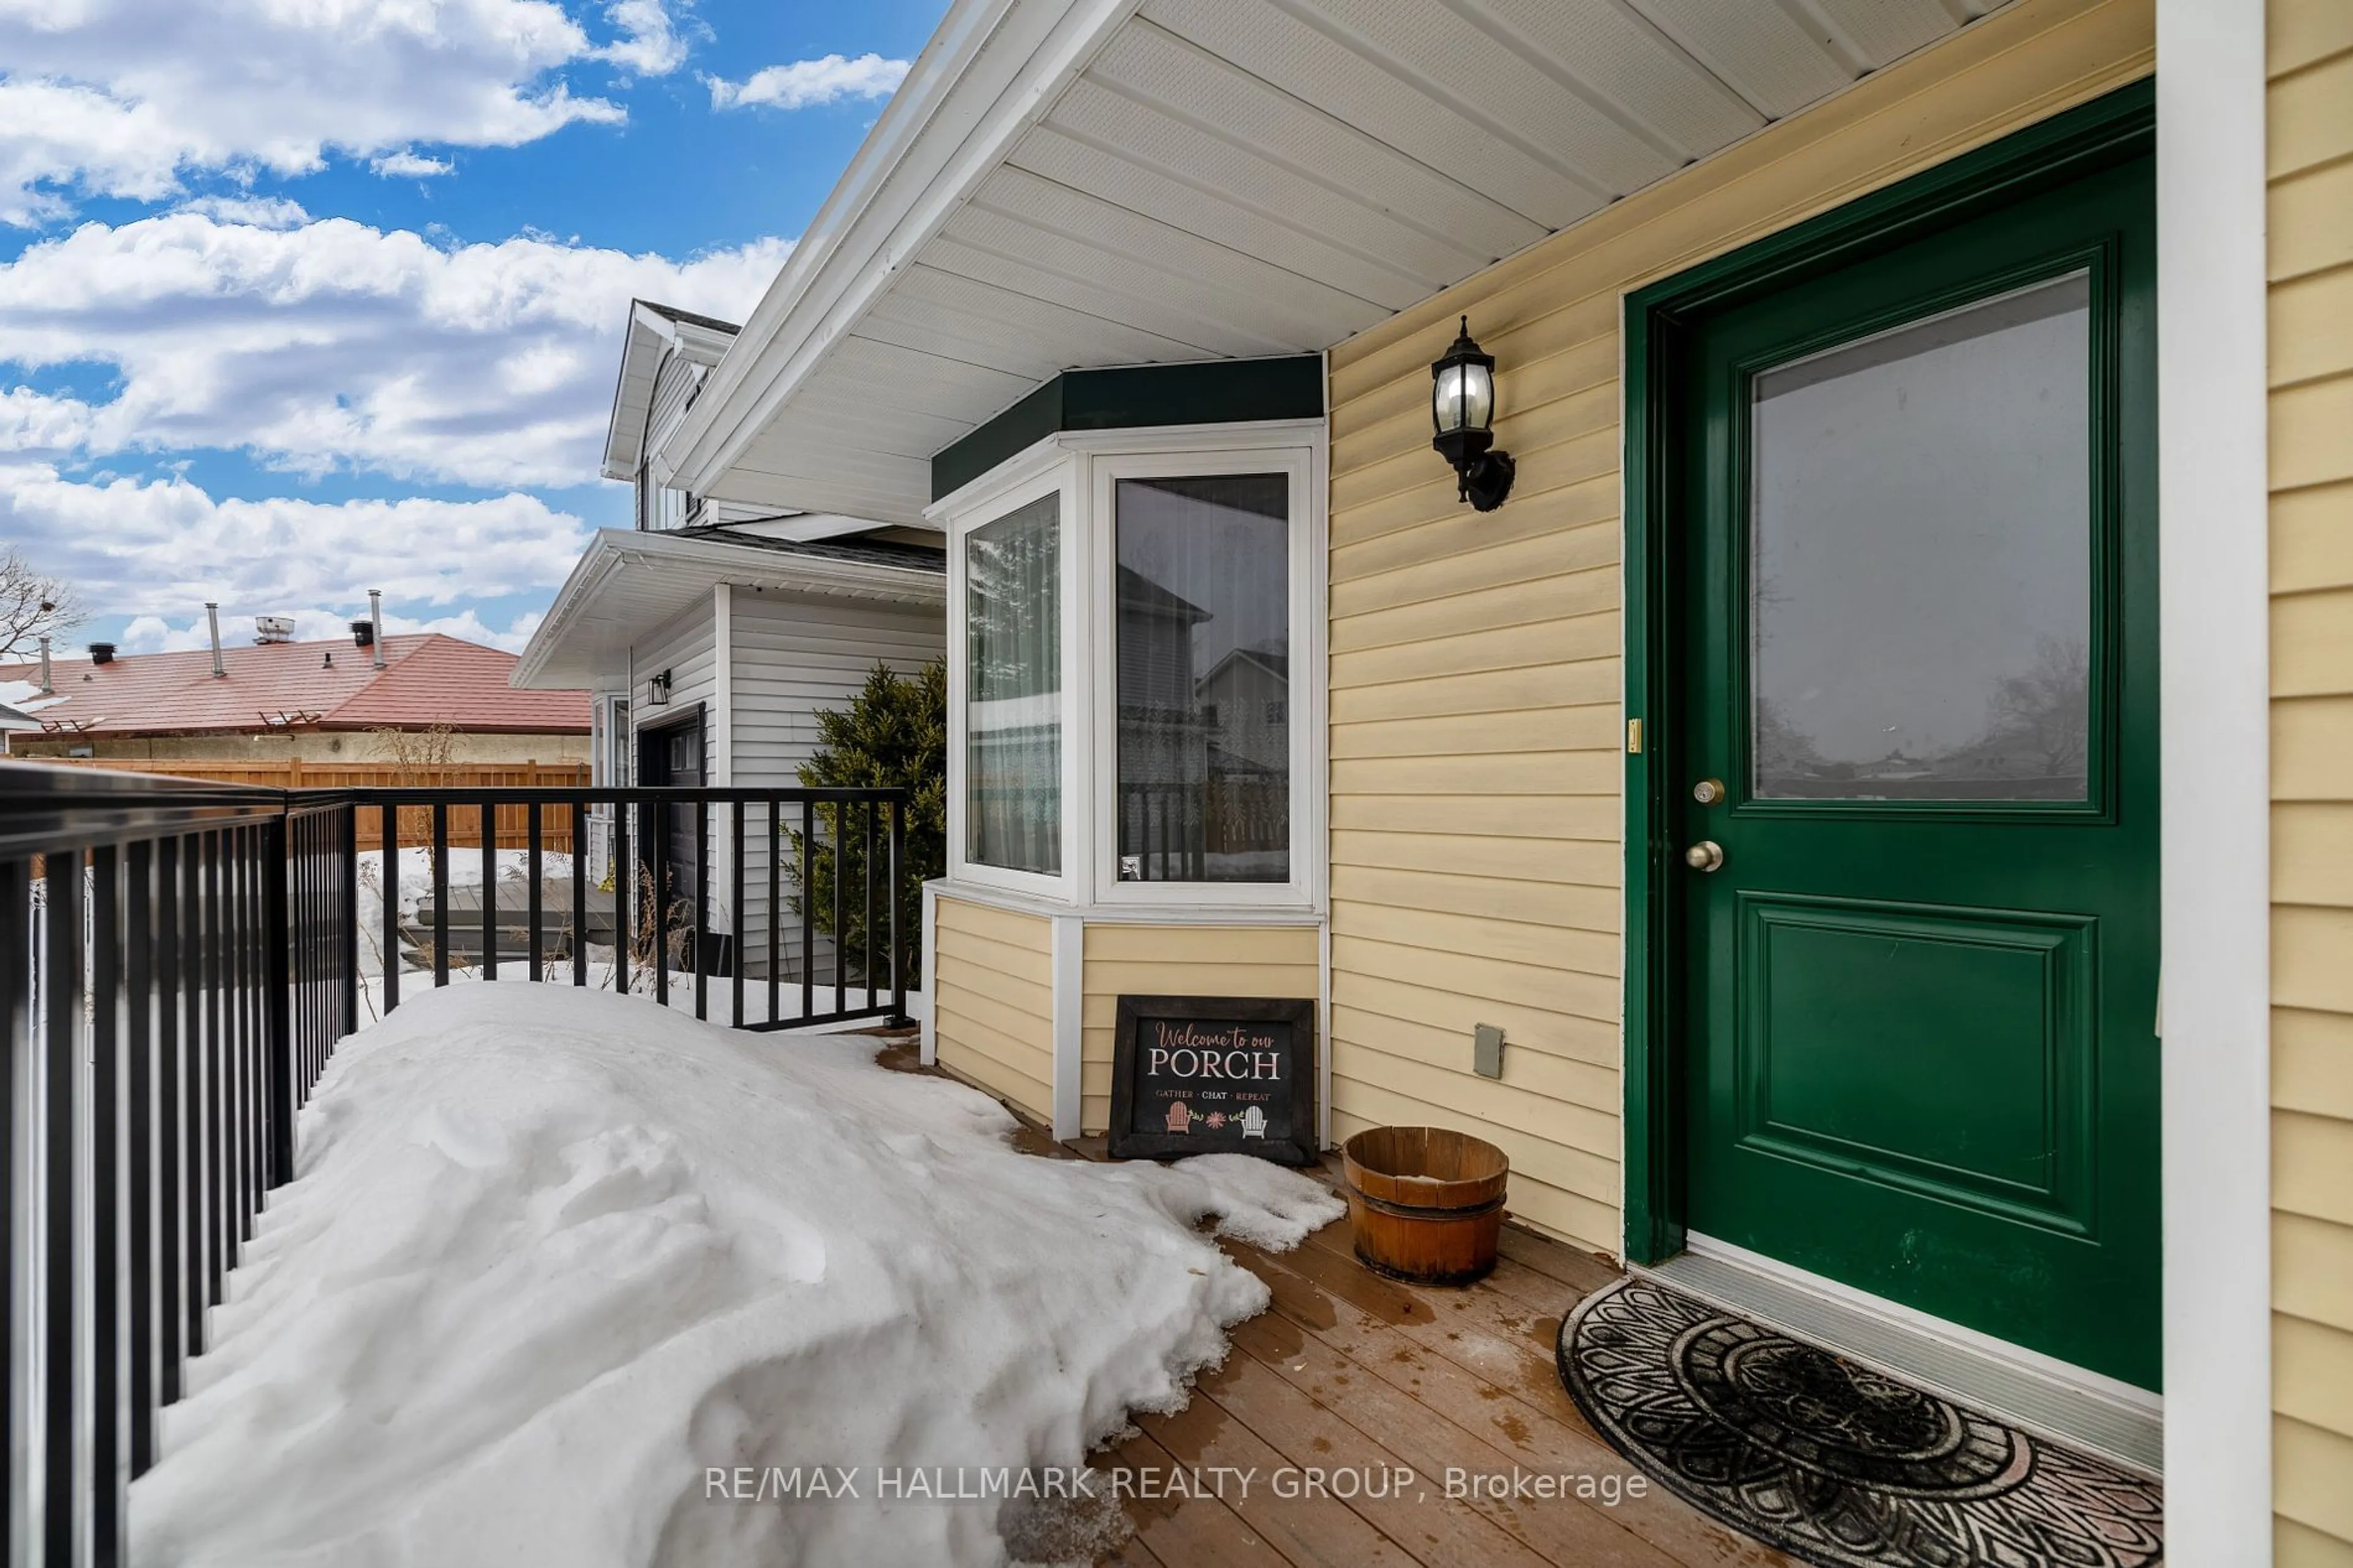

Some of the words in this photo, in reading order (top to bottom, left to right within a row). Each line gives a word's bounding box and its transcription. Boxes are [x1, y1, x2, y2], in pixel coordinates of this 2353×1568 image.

[1156, 1021, 1230, 1048] Welcome
[1227, 1026, 1248, 1049] to
[1251, 1036, 1275, 1048] our
[1147, 1048, 1281, 1080] PORCH
[1155, 1089, 1194, 1099] GATHER
[1202, 1091, 1228, 1100] CHAT
[1235, 1092, 1271, 1101] REPEAT
